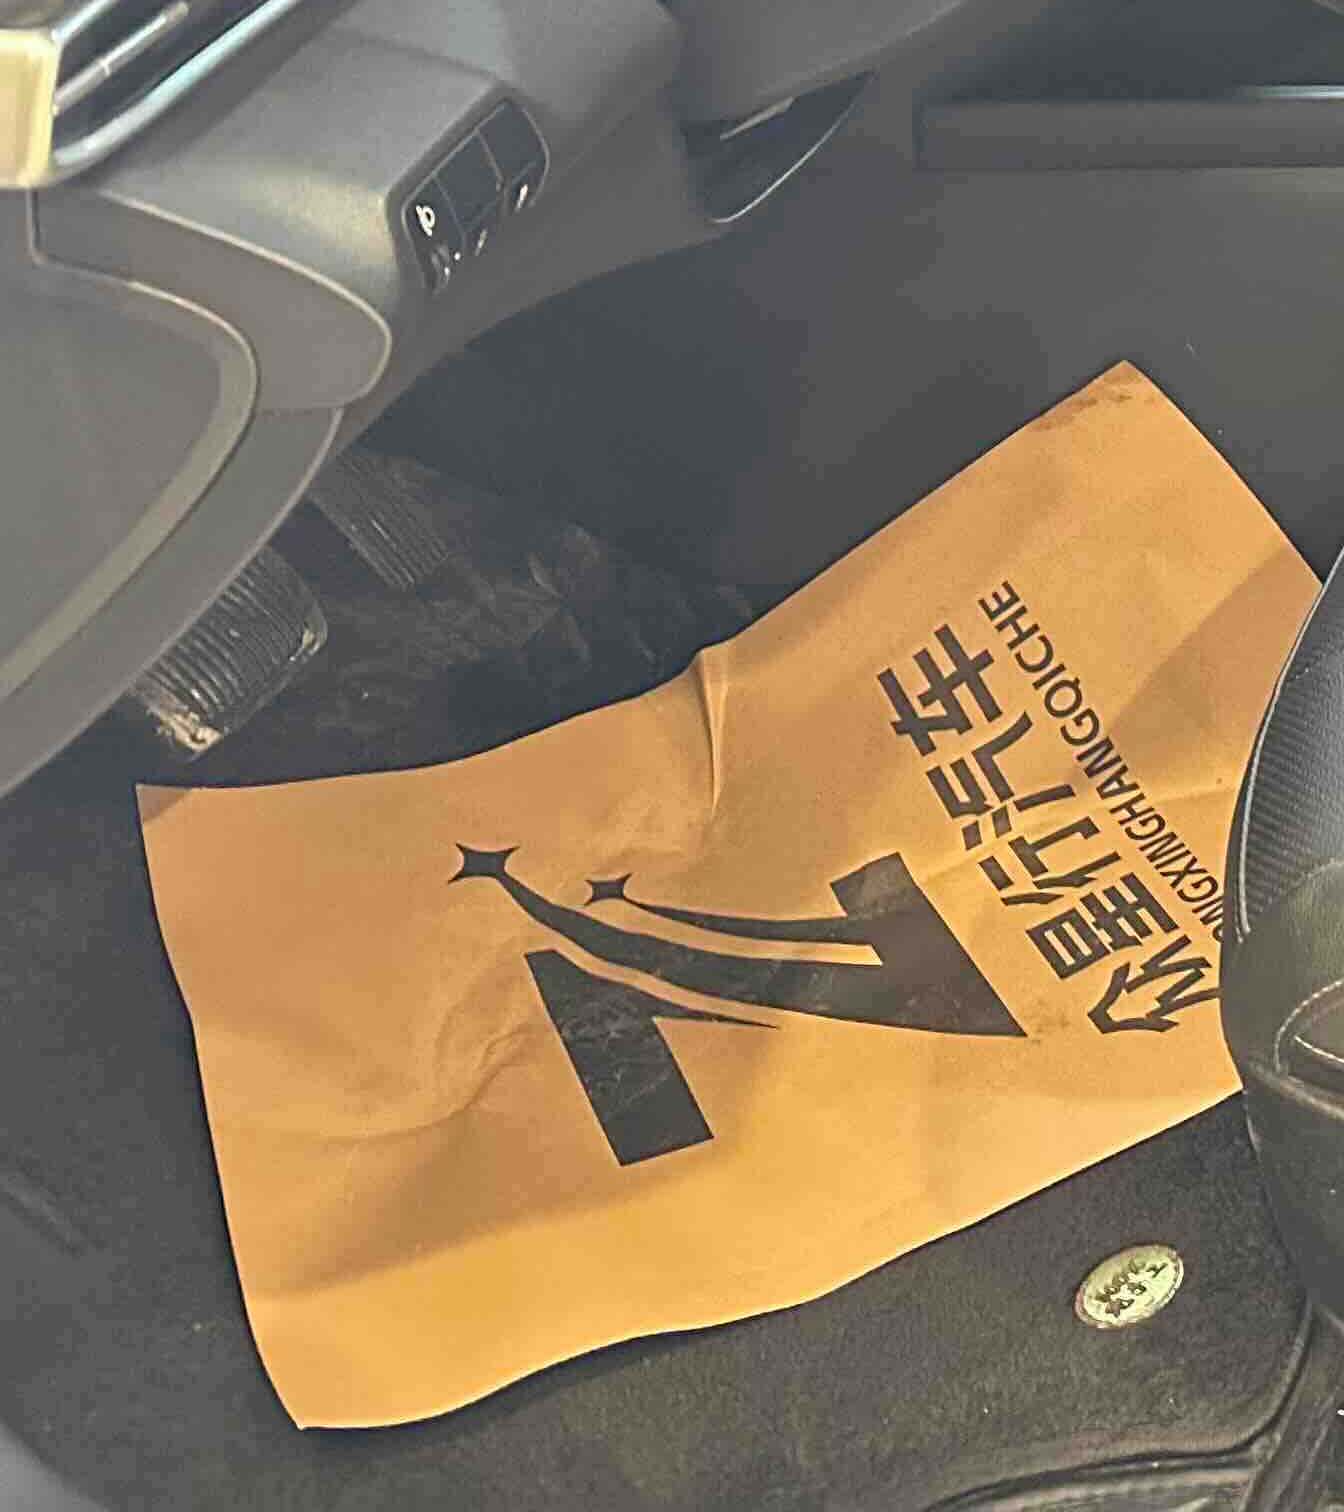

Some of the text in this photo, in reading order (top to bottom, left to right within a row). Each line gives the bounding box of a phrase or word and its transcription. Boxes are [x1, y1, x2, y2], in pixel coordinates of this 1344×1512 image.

[876, 623, 1221, 1034] 众星行汽车
